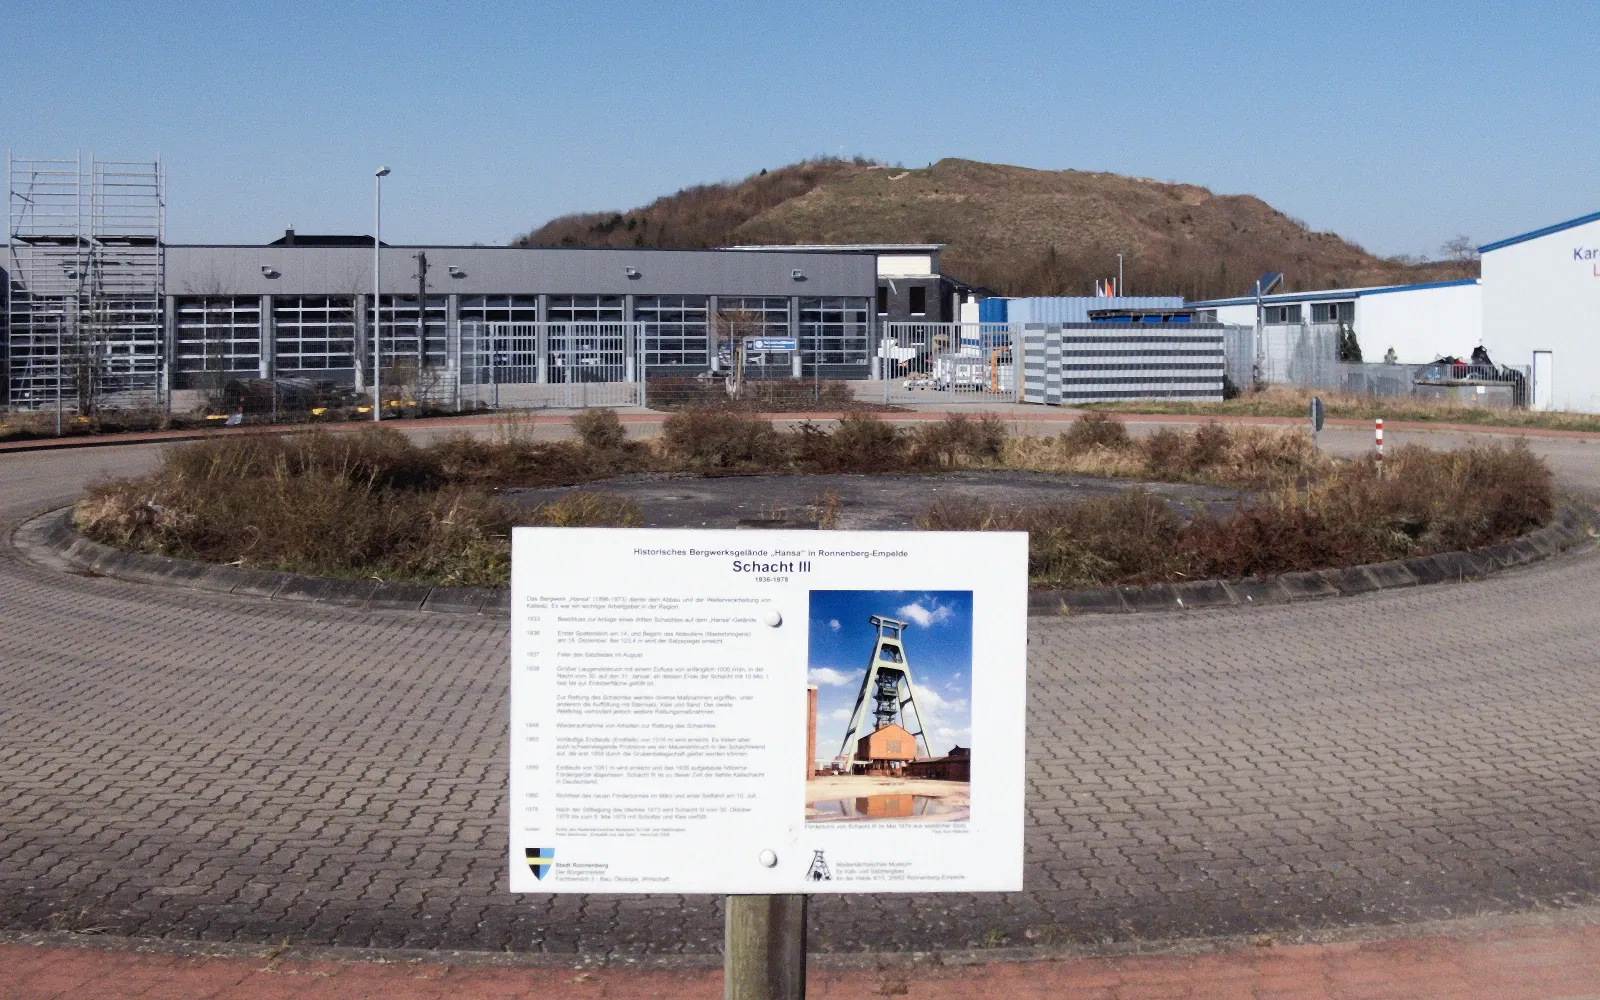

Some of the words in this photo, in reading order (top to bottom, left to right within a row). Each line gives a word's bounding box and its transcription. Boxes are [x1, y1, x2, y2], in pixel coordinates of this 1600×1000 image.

[1573, 247, 1600, 260] Kar
[689, 549, 768, 558] Bergwerksgelände
[818, 550, 908, 558] Ronnenberg-Empelde
[732, 560, 794, 573] Schacht
[799, 561, 812, 572] III
